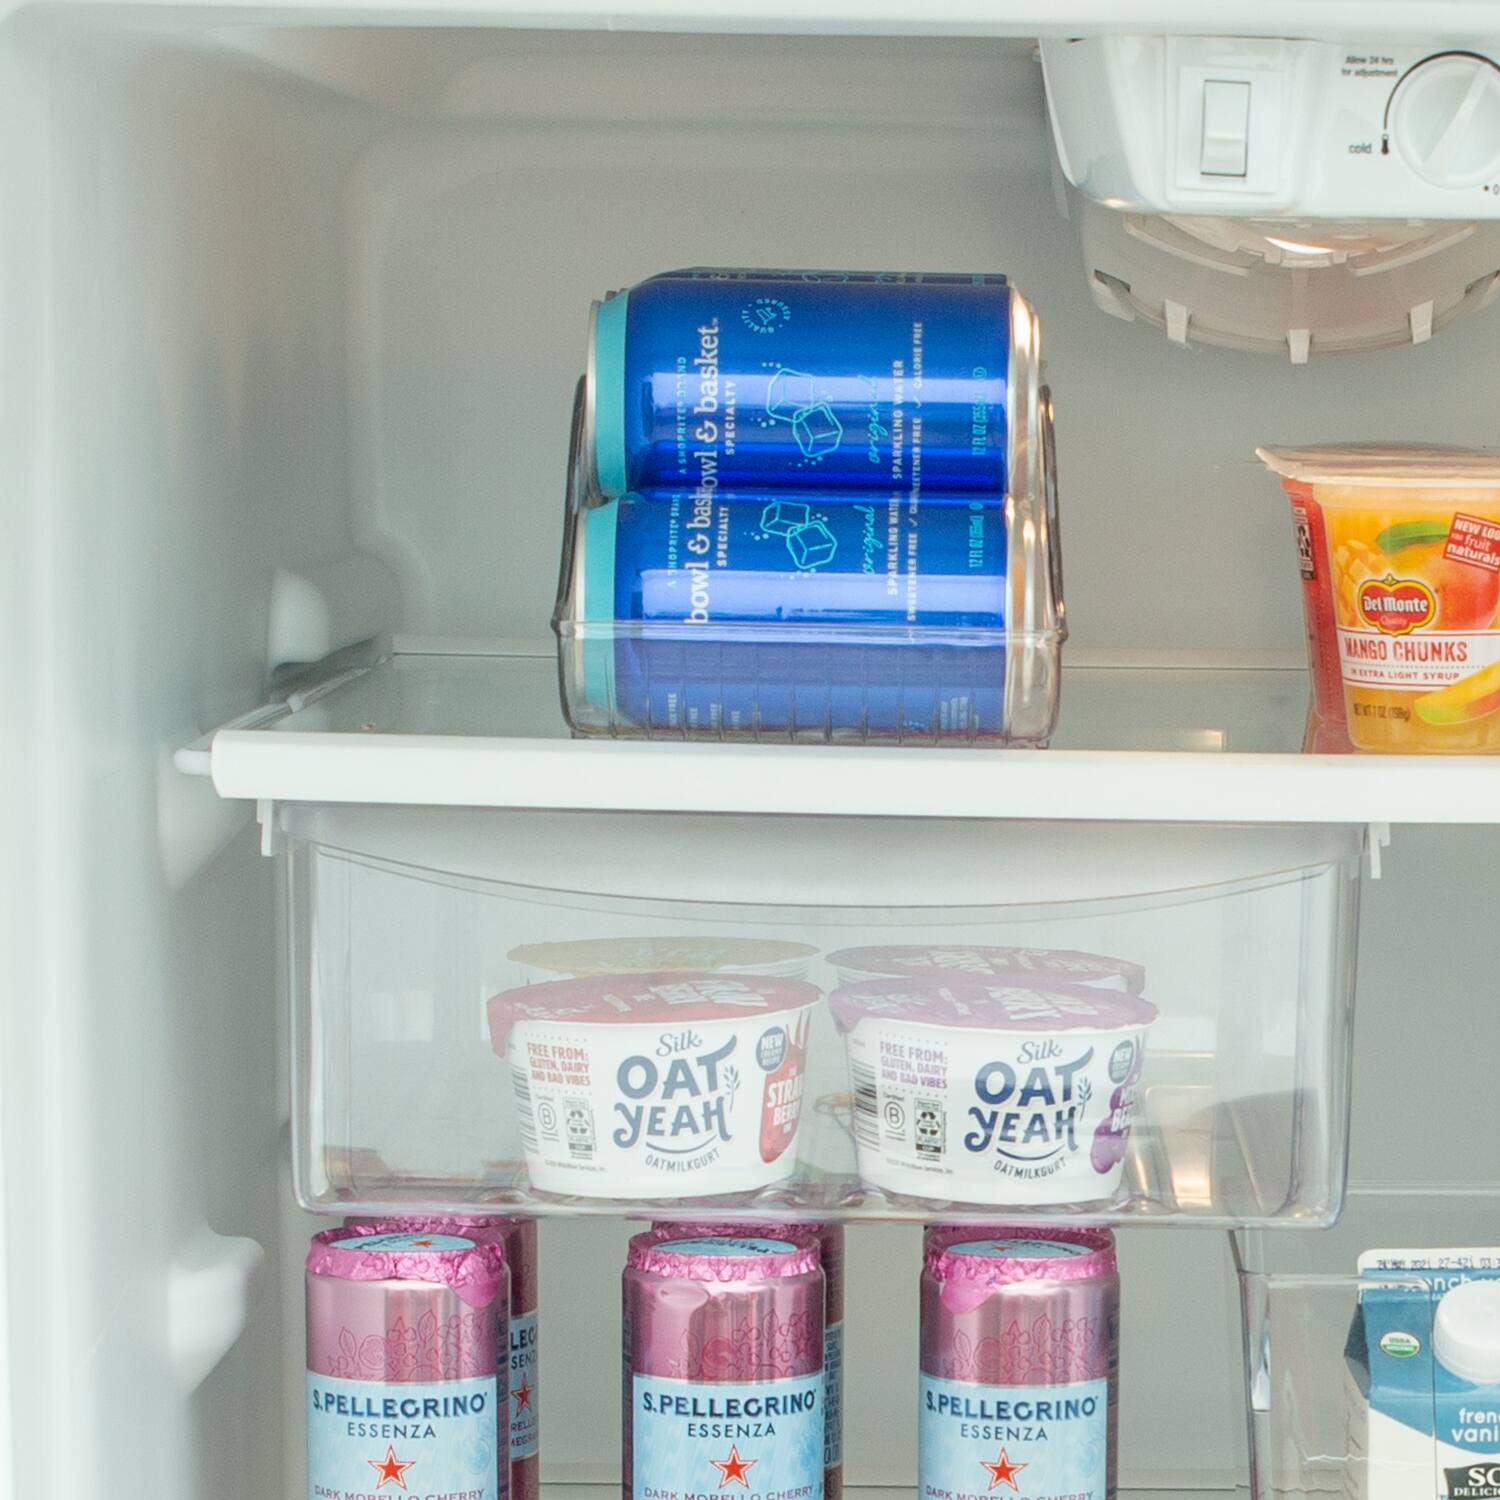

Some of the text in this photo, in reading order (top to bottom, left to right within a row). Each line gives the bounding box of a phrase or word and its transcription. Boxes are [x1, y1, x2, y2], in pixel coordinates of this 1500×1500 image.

[1348, 143, 1372, 154] cold
[693, 324, 719, 443] & basket
[725, 381, 736, 456] SPECIALTY
[892, 409, 904, 480] SPARKLING
[1454, 518, 1481, 535] NEW
[1464, 534, 1492, 552] fruit
[887, 527, 899, 596] SPARKLING
[684, 532, 711, 624] bowl &
[1363, 595, 1428, 612] Del Monte
[1393, 641, 1468, 662] CHUNKS
[1387, 671, 1460, 681] LIGHT SYRUP
[527, 1042, 589, 1062] FREE FROM:
[656, 1030, 700, 1056] Silk
[880, 1041, 949, 1065] FREE FROM:
[1016, 1039, 1061, 1064] Silk
[616, 1034, 737, 1100] OAT
[917, 1061, 948, 1077] DAIRY
[974, 1046, 1094, 1106] OAT
[565, 1073, 591, 1086] VIBES
[920, 1076, 948, 1090] VIBES
[613, 1096, 732, 1149] YEAH
[964, 1106, 1078, 1152] YEAH
[645, 1148, 720, 1173] OATMILKGURT
[993, 1157, 1067, 1180] OATMILKGURT
[313, 1388, 486, 1419] S.PELLEGRINO
[642, 1389, 815, 1418] S.PELLEGRINO
[926, 1389, 1097, 1421] S.PELLEGRINO
[347, 1421, 437, 1439] ESSENZA
[687, 1422, 777, 1439] ESSENZA
[960, 1423, 1049, 1442] ESSENZA
[314, 1484, 341, 1500] DARK
